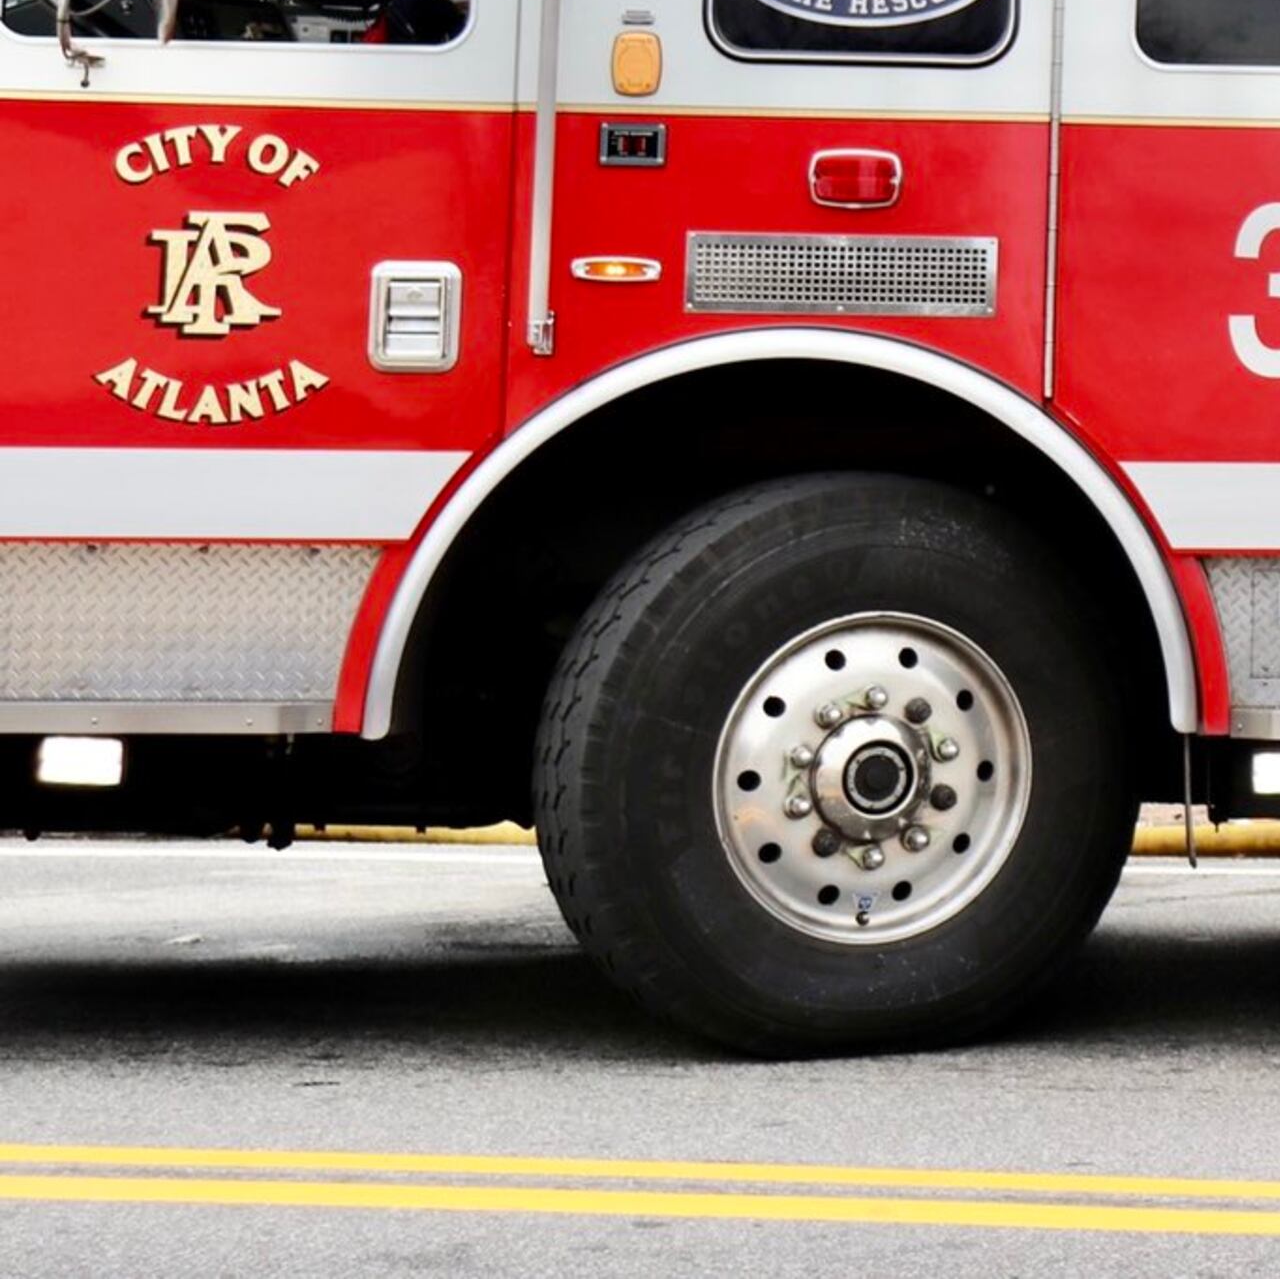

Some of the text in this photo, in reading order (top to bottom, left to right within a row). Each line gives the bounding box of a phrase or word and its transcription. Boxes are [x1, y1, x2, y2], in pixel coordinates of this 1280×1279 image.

[114, 124, 320, 189] CITY OF
[95, 358, 331, 425] ATLANTA
